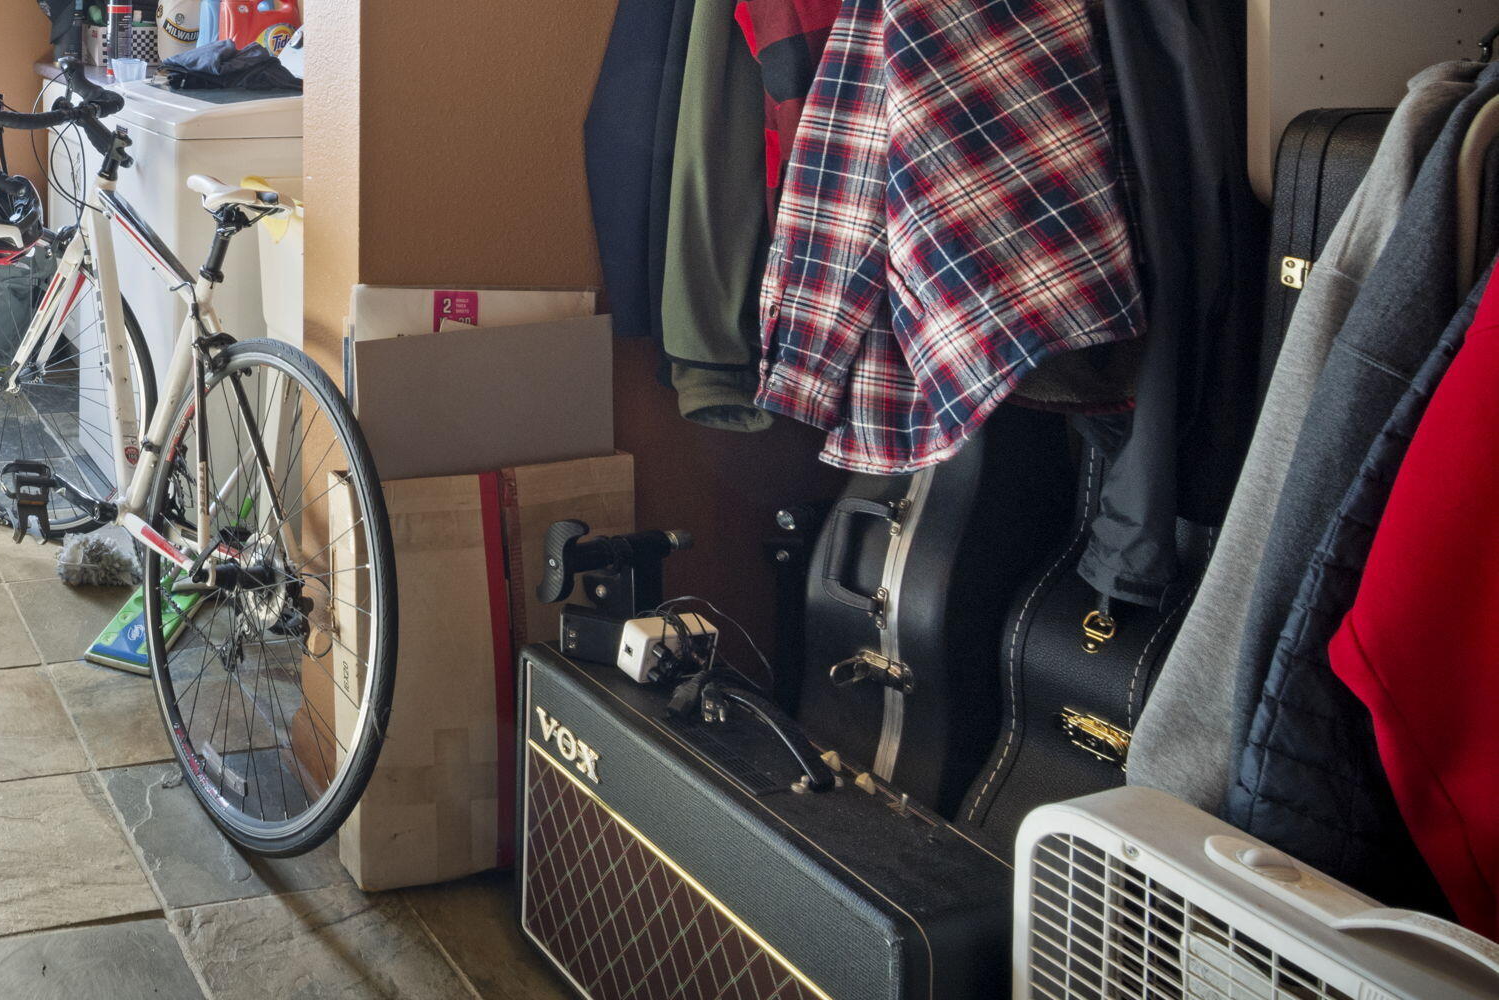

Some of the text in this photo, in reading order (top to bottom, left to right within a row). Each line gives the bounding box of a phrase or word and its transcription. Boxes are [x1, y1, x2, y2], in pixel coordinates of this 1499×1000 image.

[165, 22, 199, 42] MILWAU
[273, 34, 290, 51] Tid
[443, 298, 452, 314] 2
[536, 706, 599, 784] VOX
